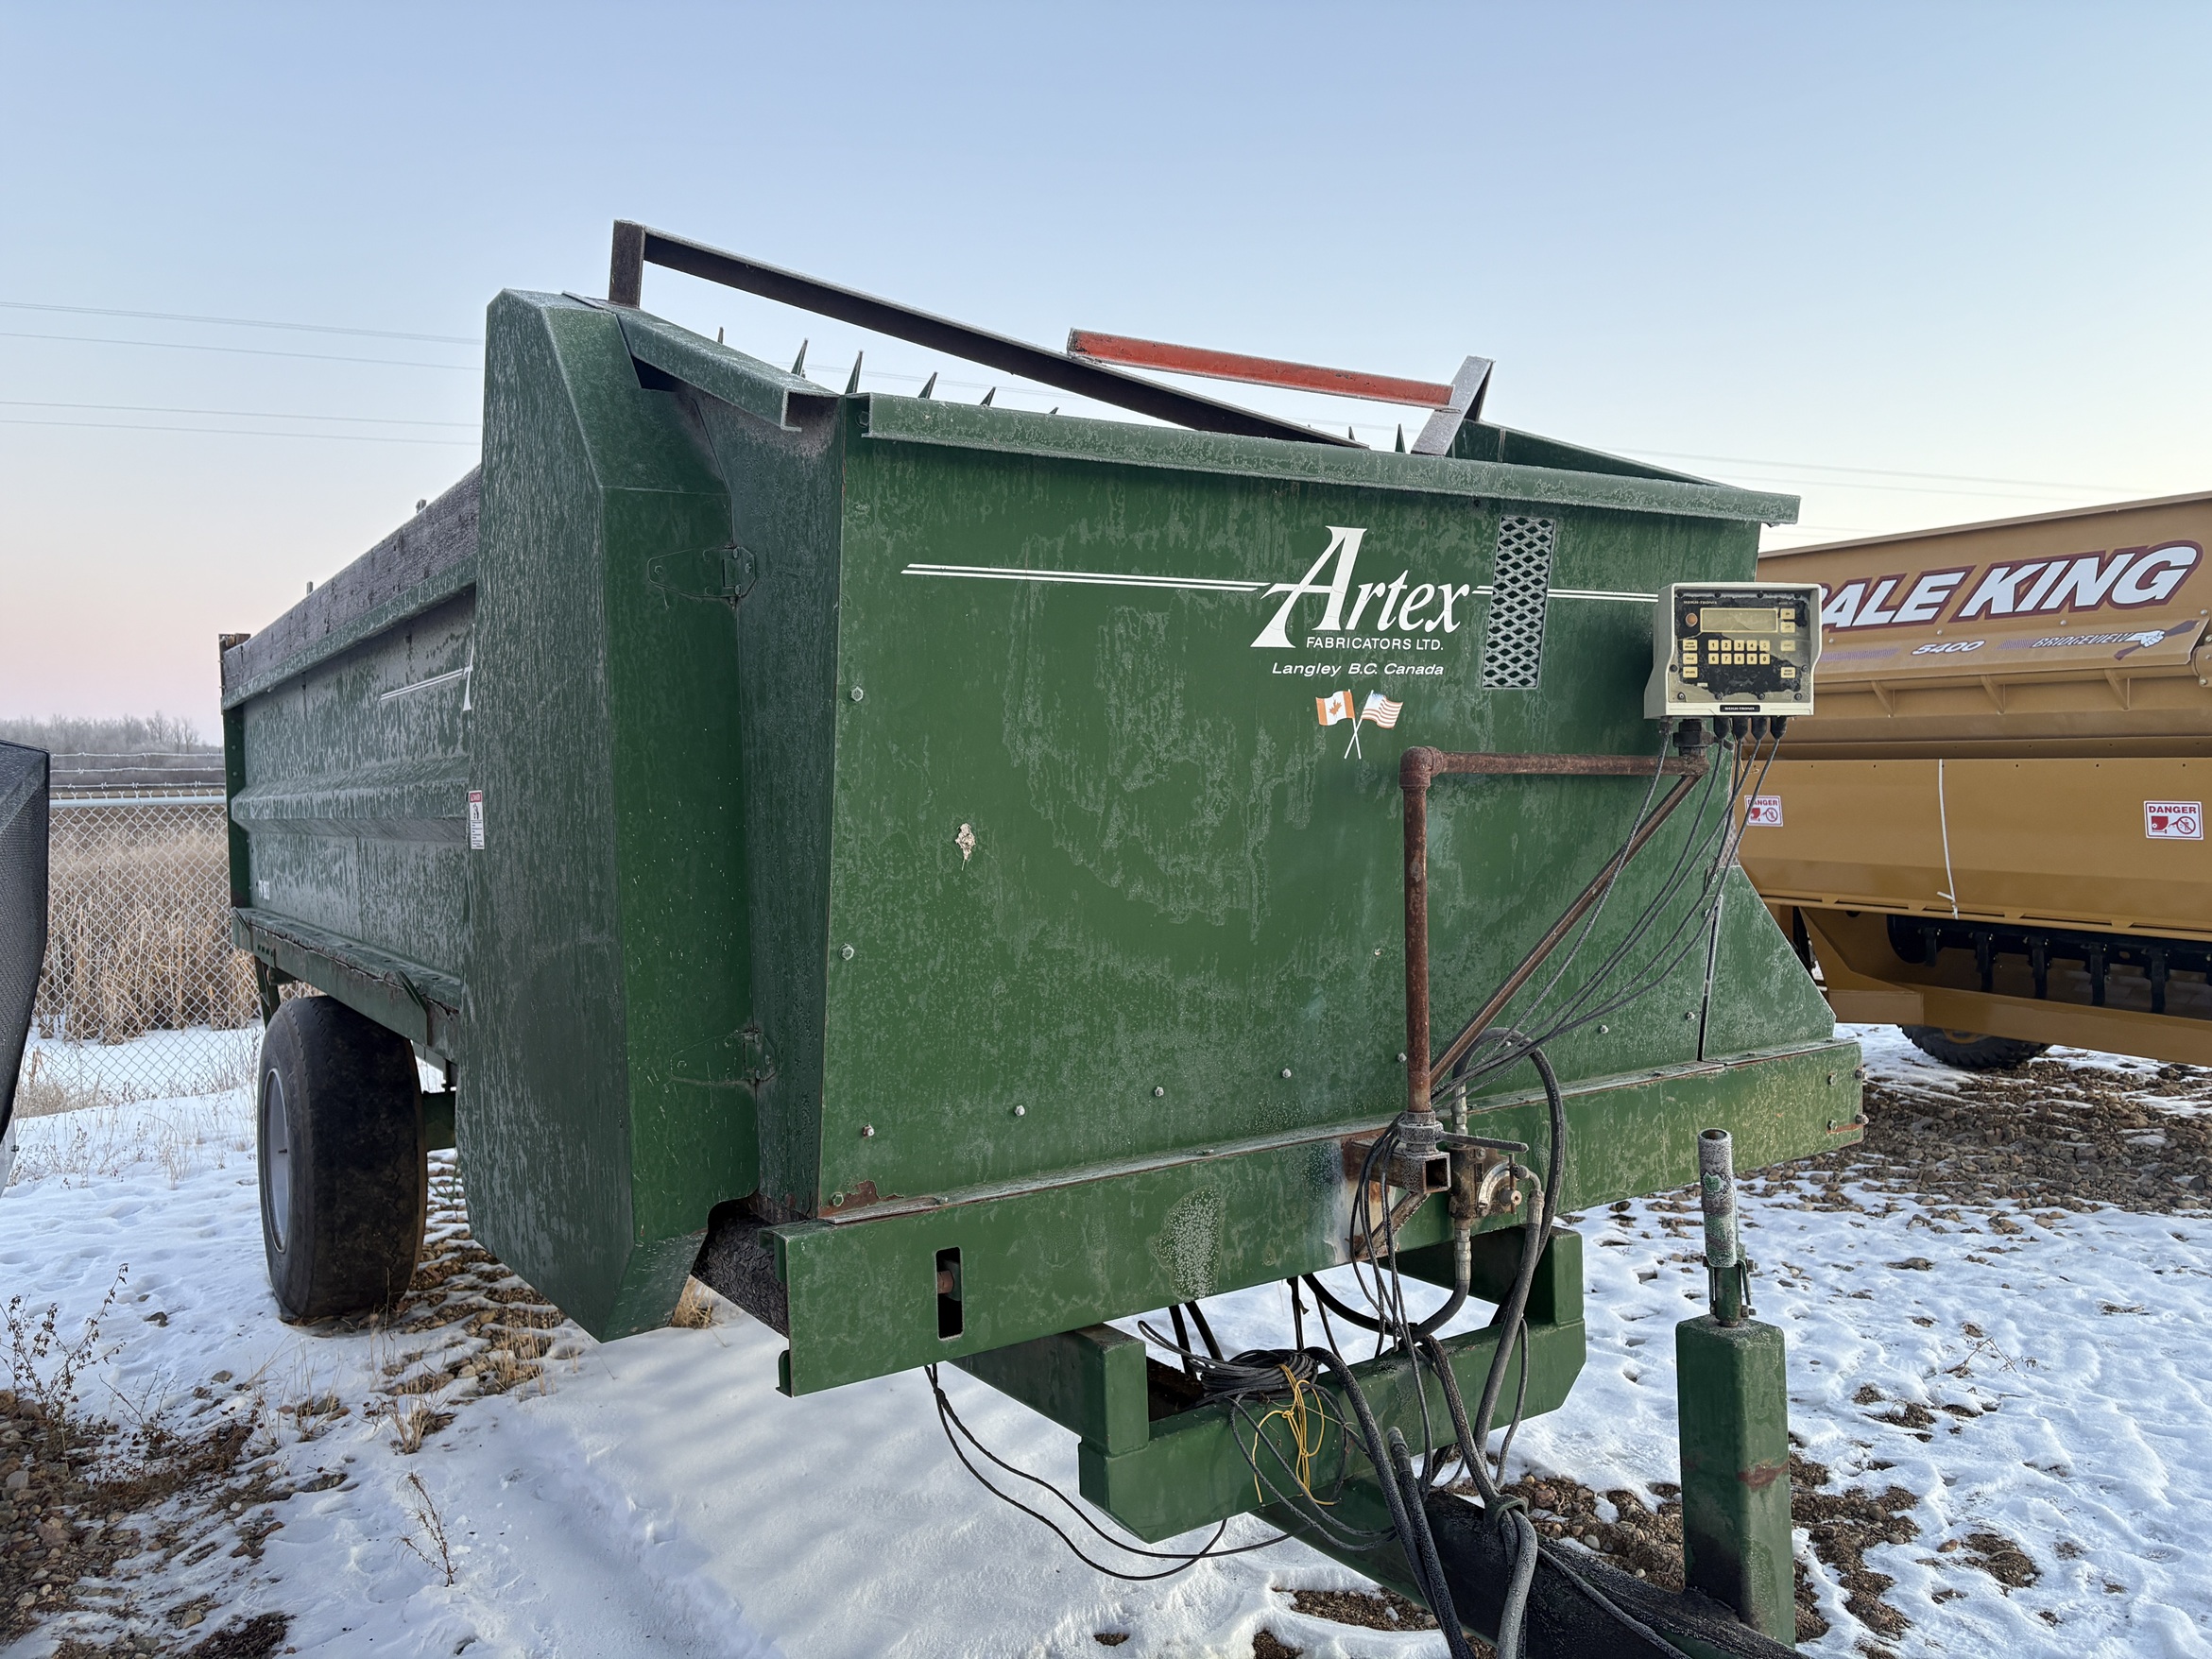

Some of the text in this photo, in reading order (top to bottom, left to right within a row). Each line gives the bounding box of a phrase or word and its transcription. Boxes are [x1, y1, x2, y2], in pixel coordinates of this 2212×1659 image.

[1250, 525, 1470, 649] Artex
[1822, 544, 2200, 629] ALE KING
[1306, 636, 1445, 652] FABRICATORS LTD.
[1911, 640, 1986, 656] 5400
[2032, 632, 2135, 649] BRIDGEVIEW
[1272, 661, 1445, 677] Langley B.C. Canada
[2148, 806, 2197, 814] DANGER
